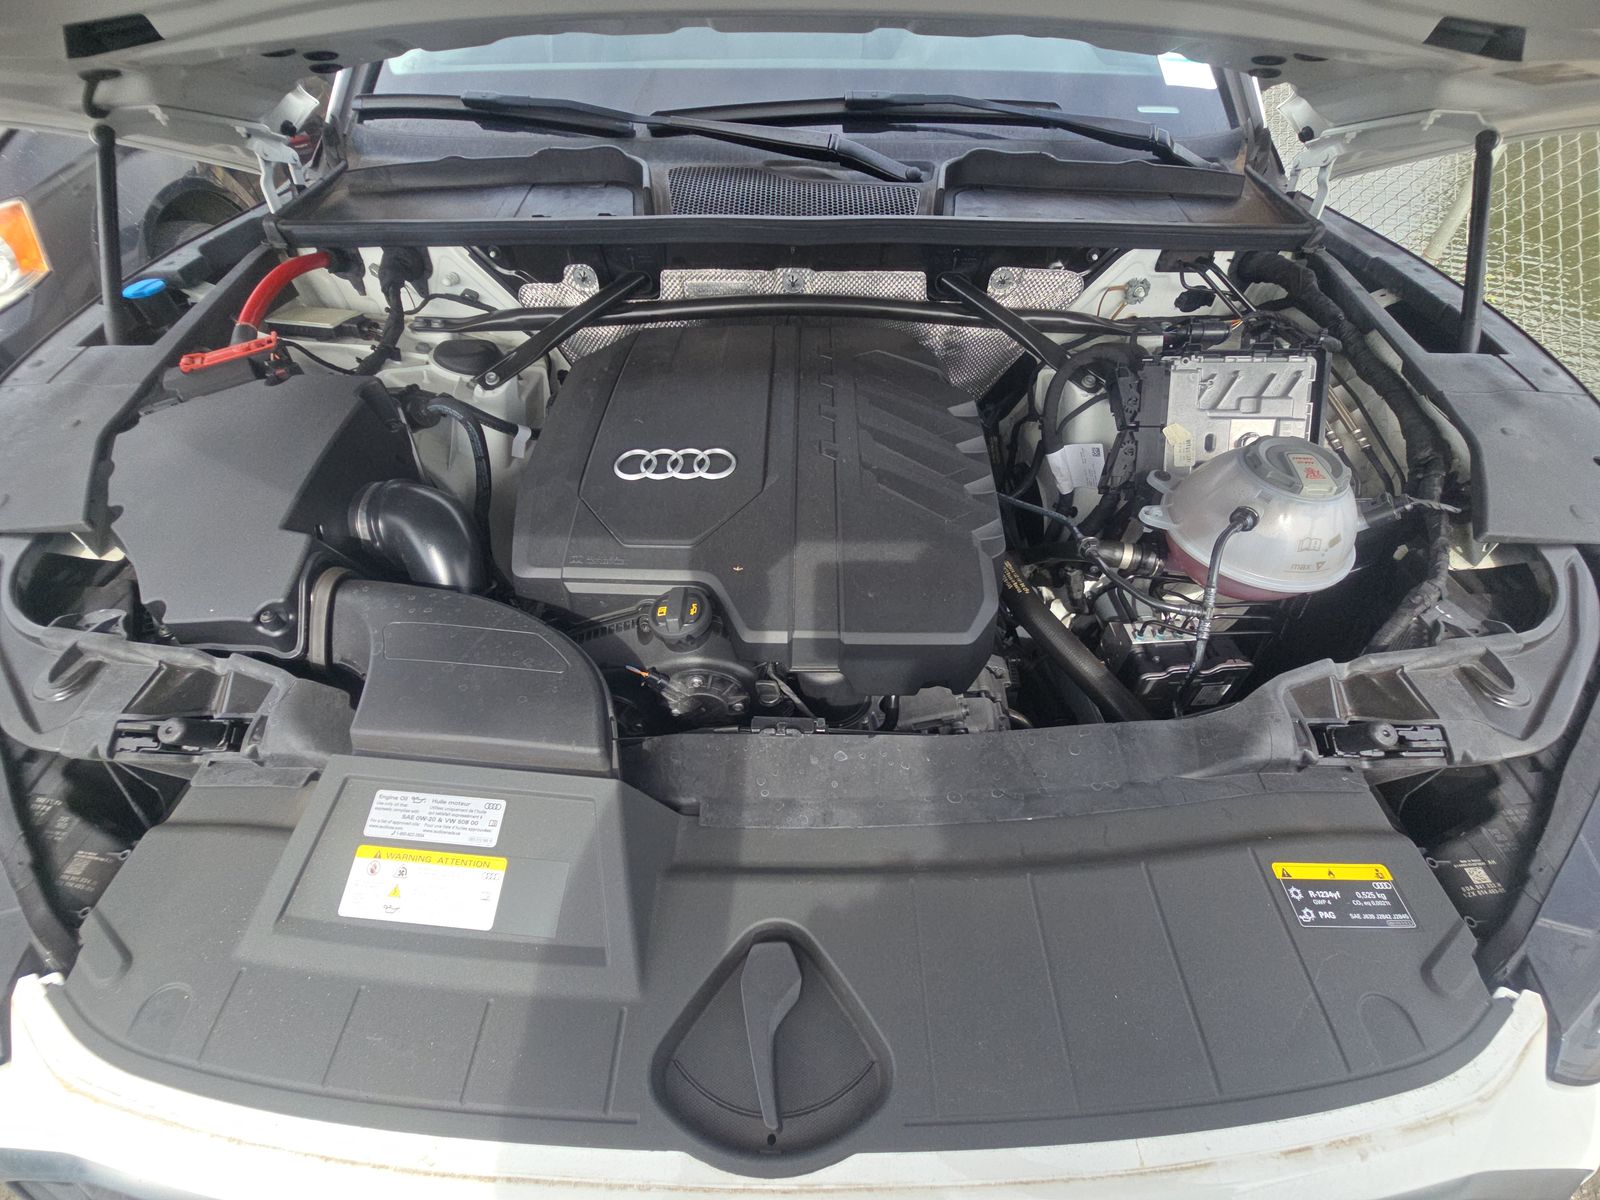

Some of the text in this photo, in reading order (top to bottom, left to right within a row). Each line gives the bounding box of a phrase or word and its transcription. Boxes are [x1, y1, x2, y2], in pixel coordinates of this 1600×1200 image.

[378, 794, 399, 802] Engine
[386, 852, 491, 868] WARNING ATTENTION
[1308, 890, 1341, 900] R-1234yf
[1377, 892, 1387, 900] kg
[1318, 911, 1337, 919] PAG
